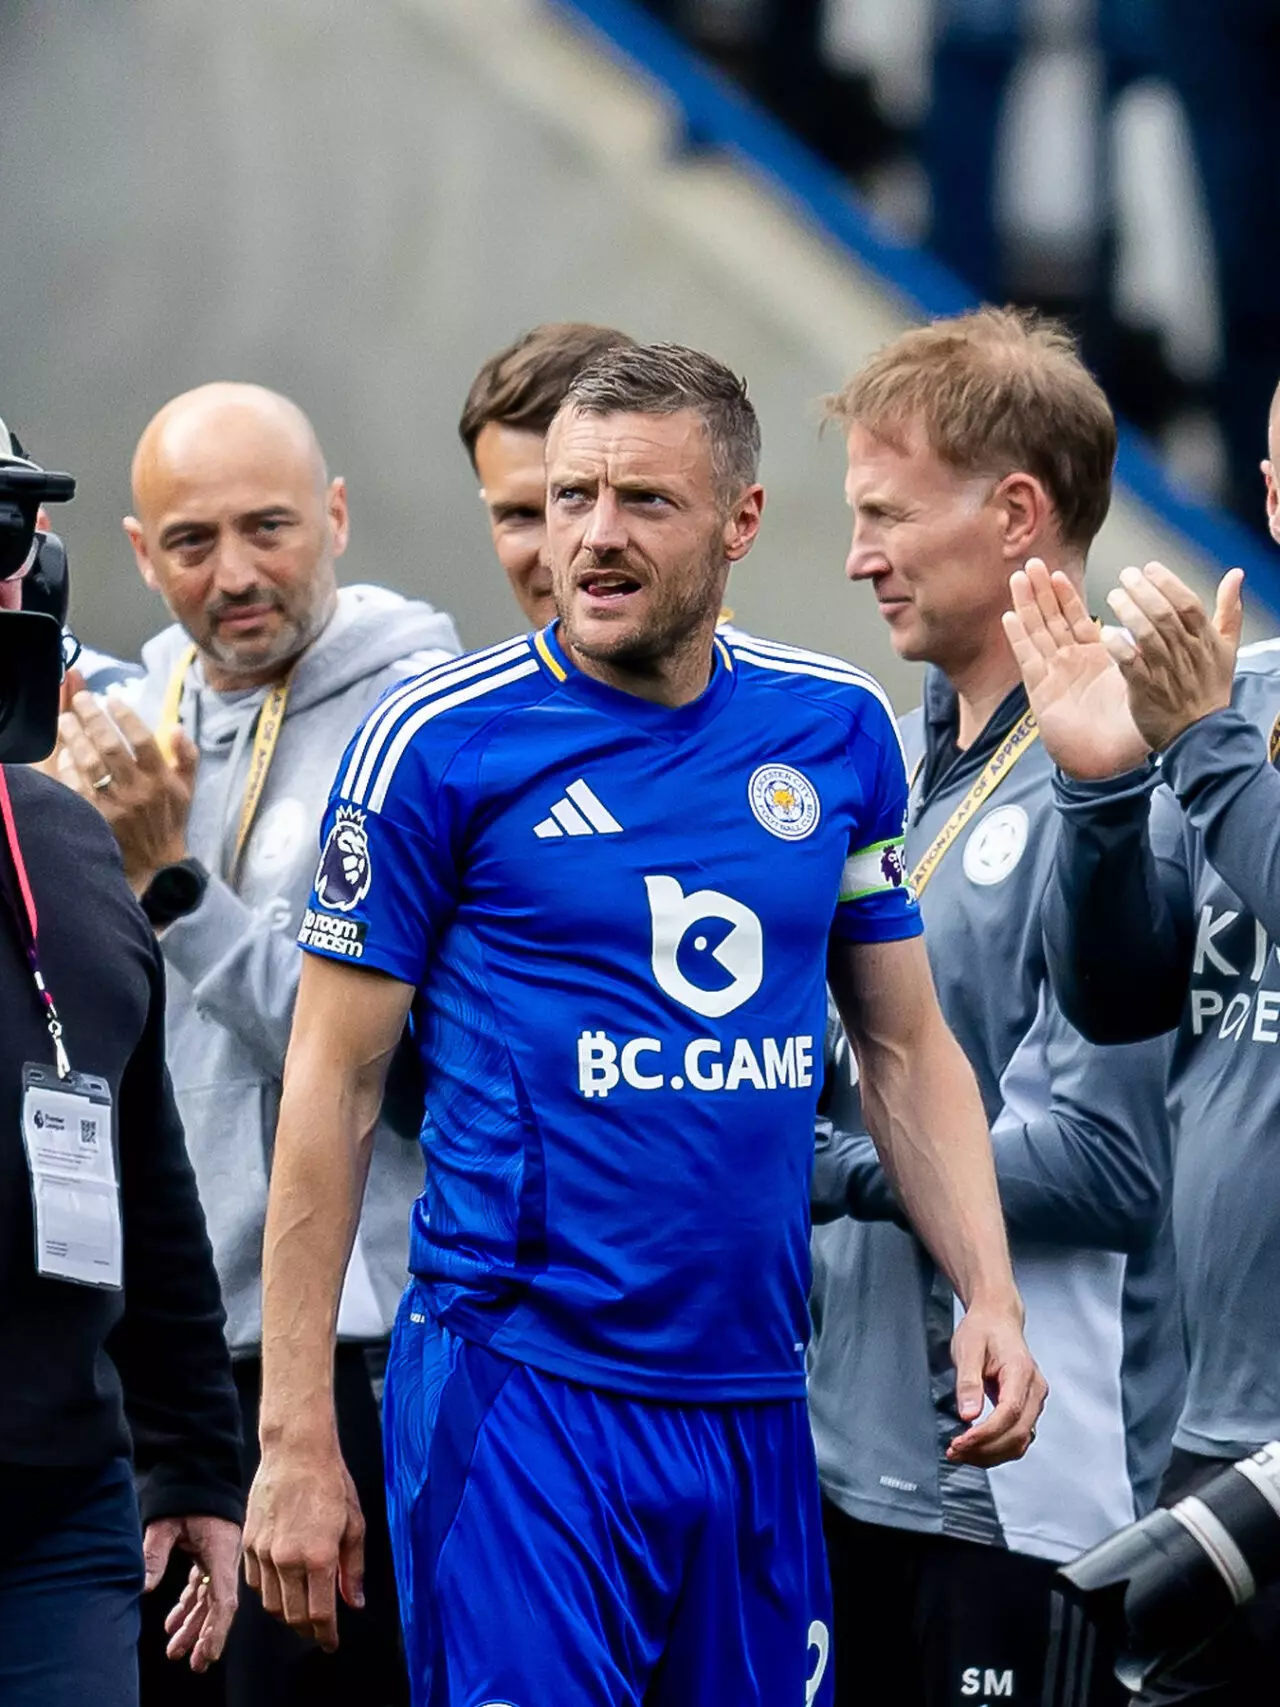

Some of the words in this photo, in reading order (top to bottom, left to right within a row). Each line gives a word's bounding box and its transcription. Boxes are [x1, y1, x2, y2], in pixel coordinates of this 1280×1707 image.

[314, 913, 358, 941] room
[309, 930, 363, 959] racism
[577, 1030, 813, 1098] BC.GAME
[960, 1666, 1014, 1697] SM
